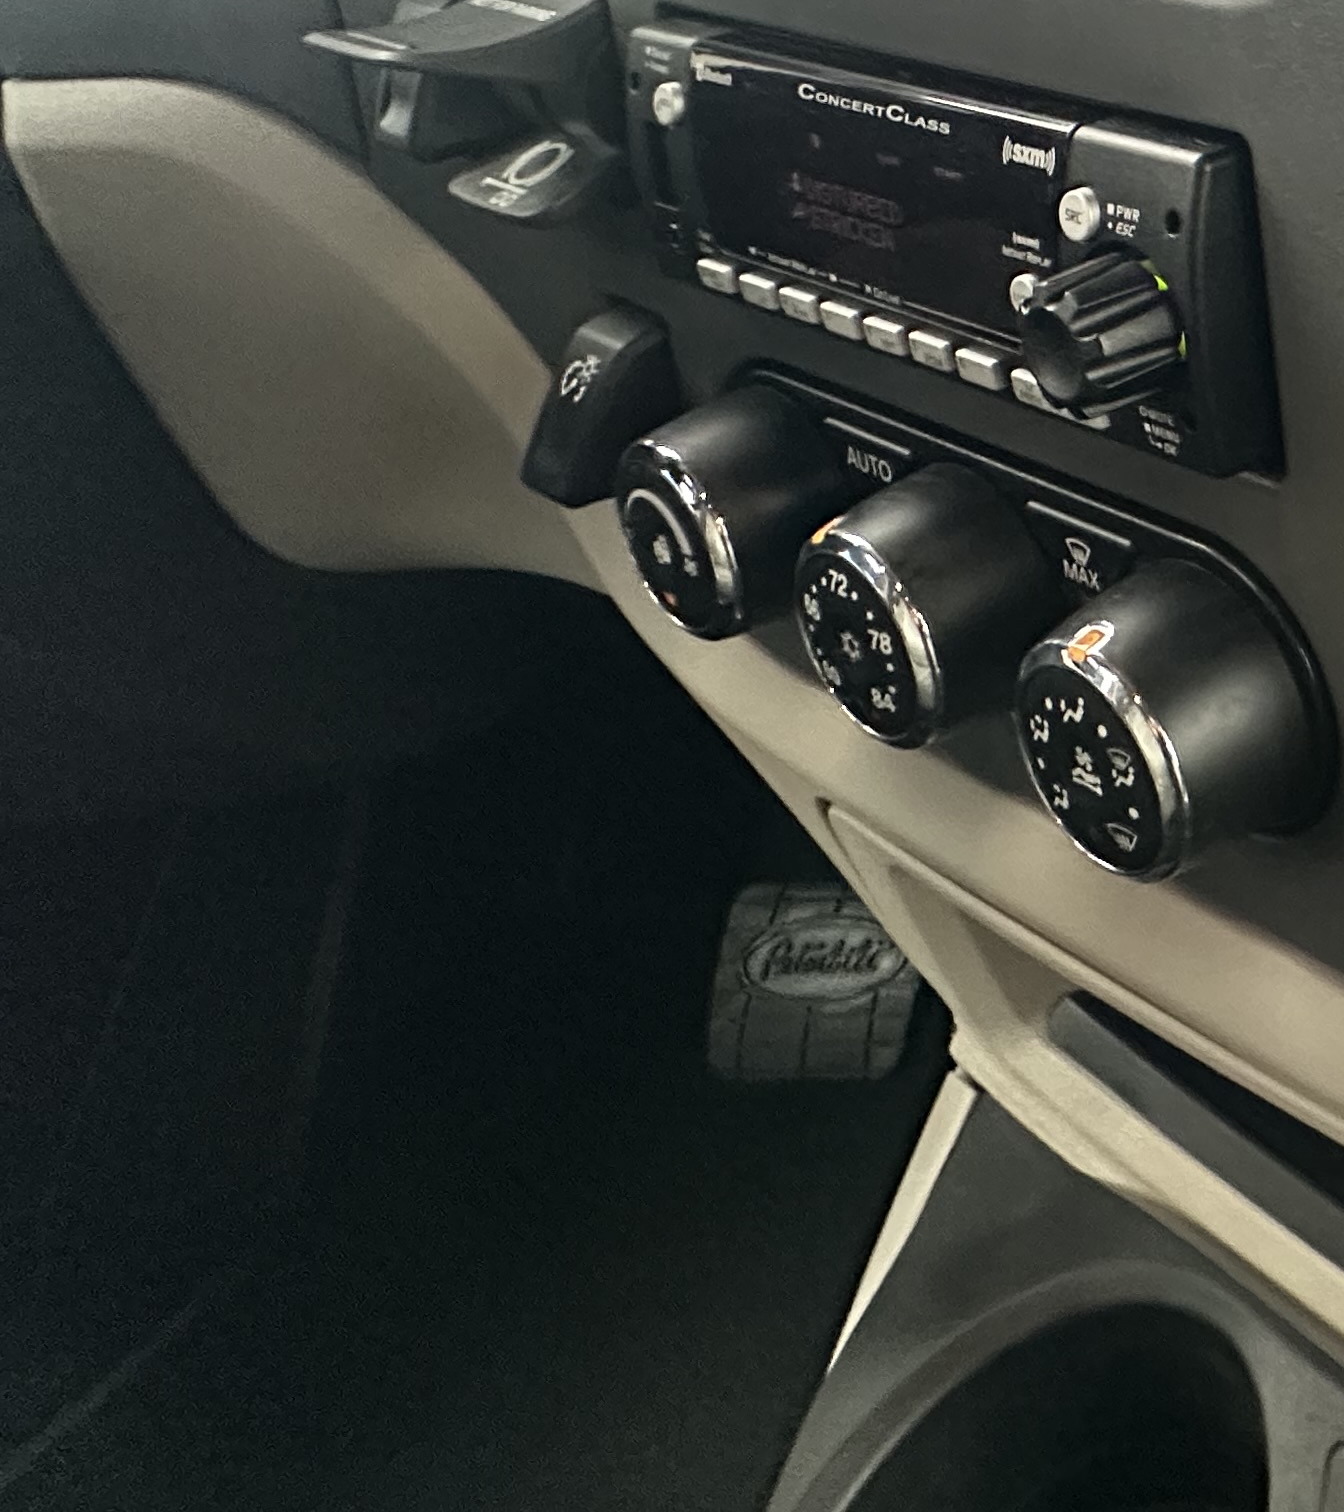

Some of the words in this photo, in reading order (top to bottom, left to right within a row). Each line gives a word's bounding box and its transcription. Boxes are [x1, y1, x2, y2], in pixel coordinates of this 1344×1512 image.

[1116, 204, 1140, 224] PWR
[1115, 222, 1137, 238] ESC
[847, 446, 892, 483] AUTO
[827, 569, 849, 598] 72
[1063, 558, 1101, 591] MAX
[867, 628, 892, 655] 78
[870, 687, 896, 713] 84
